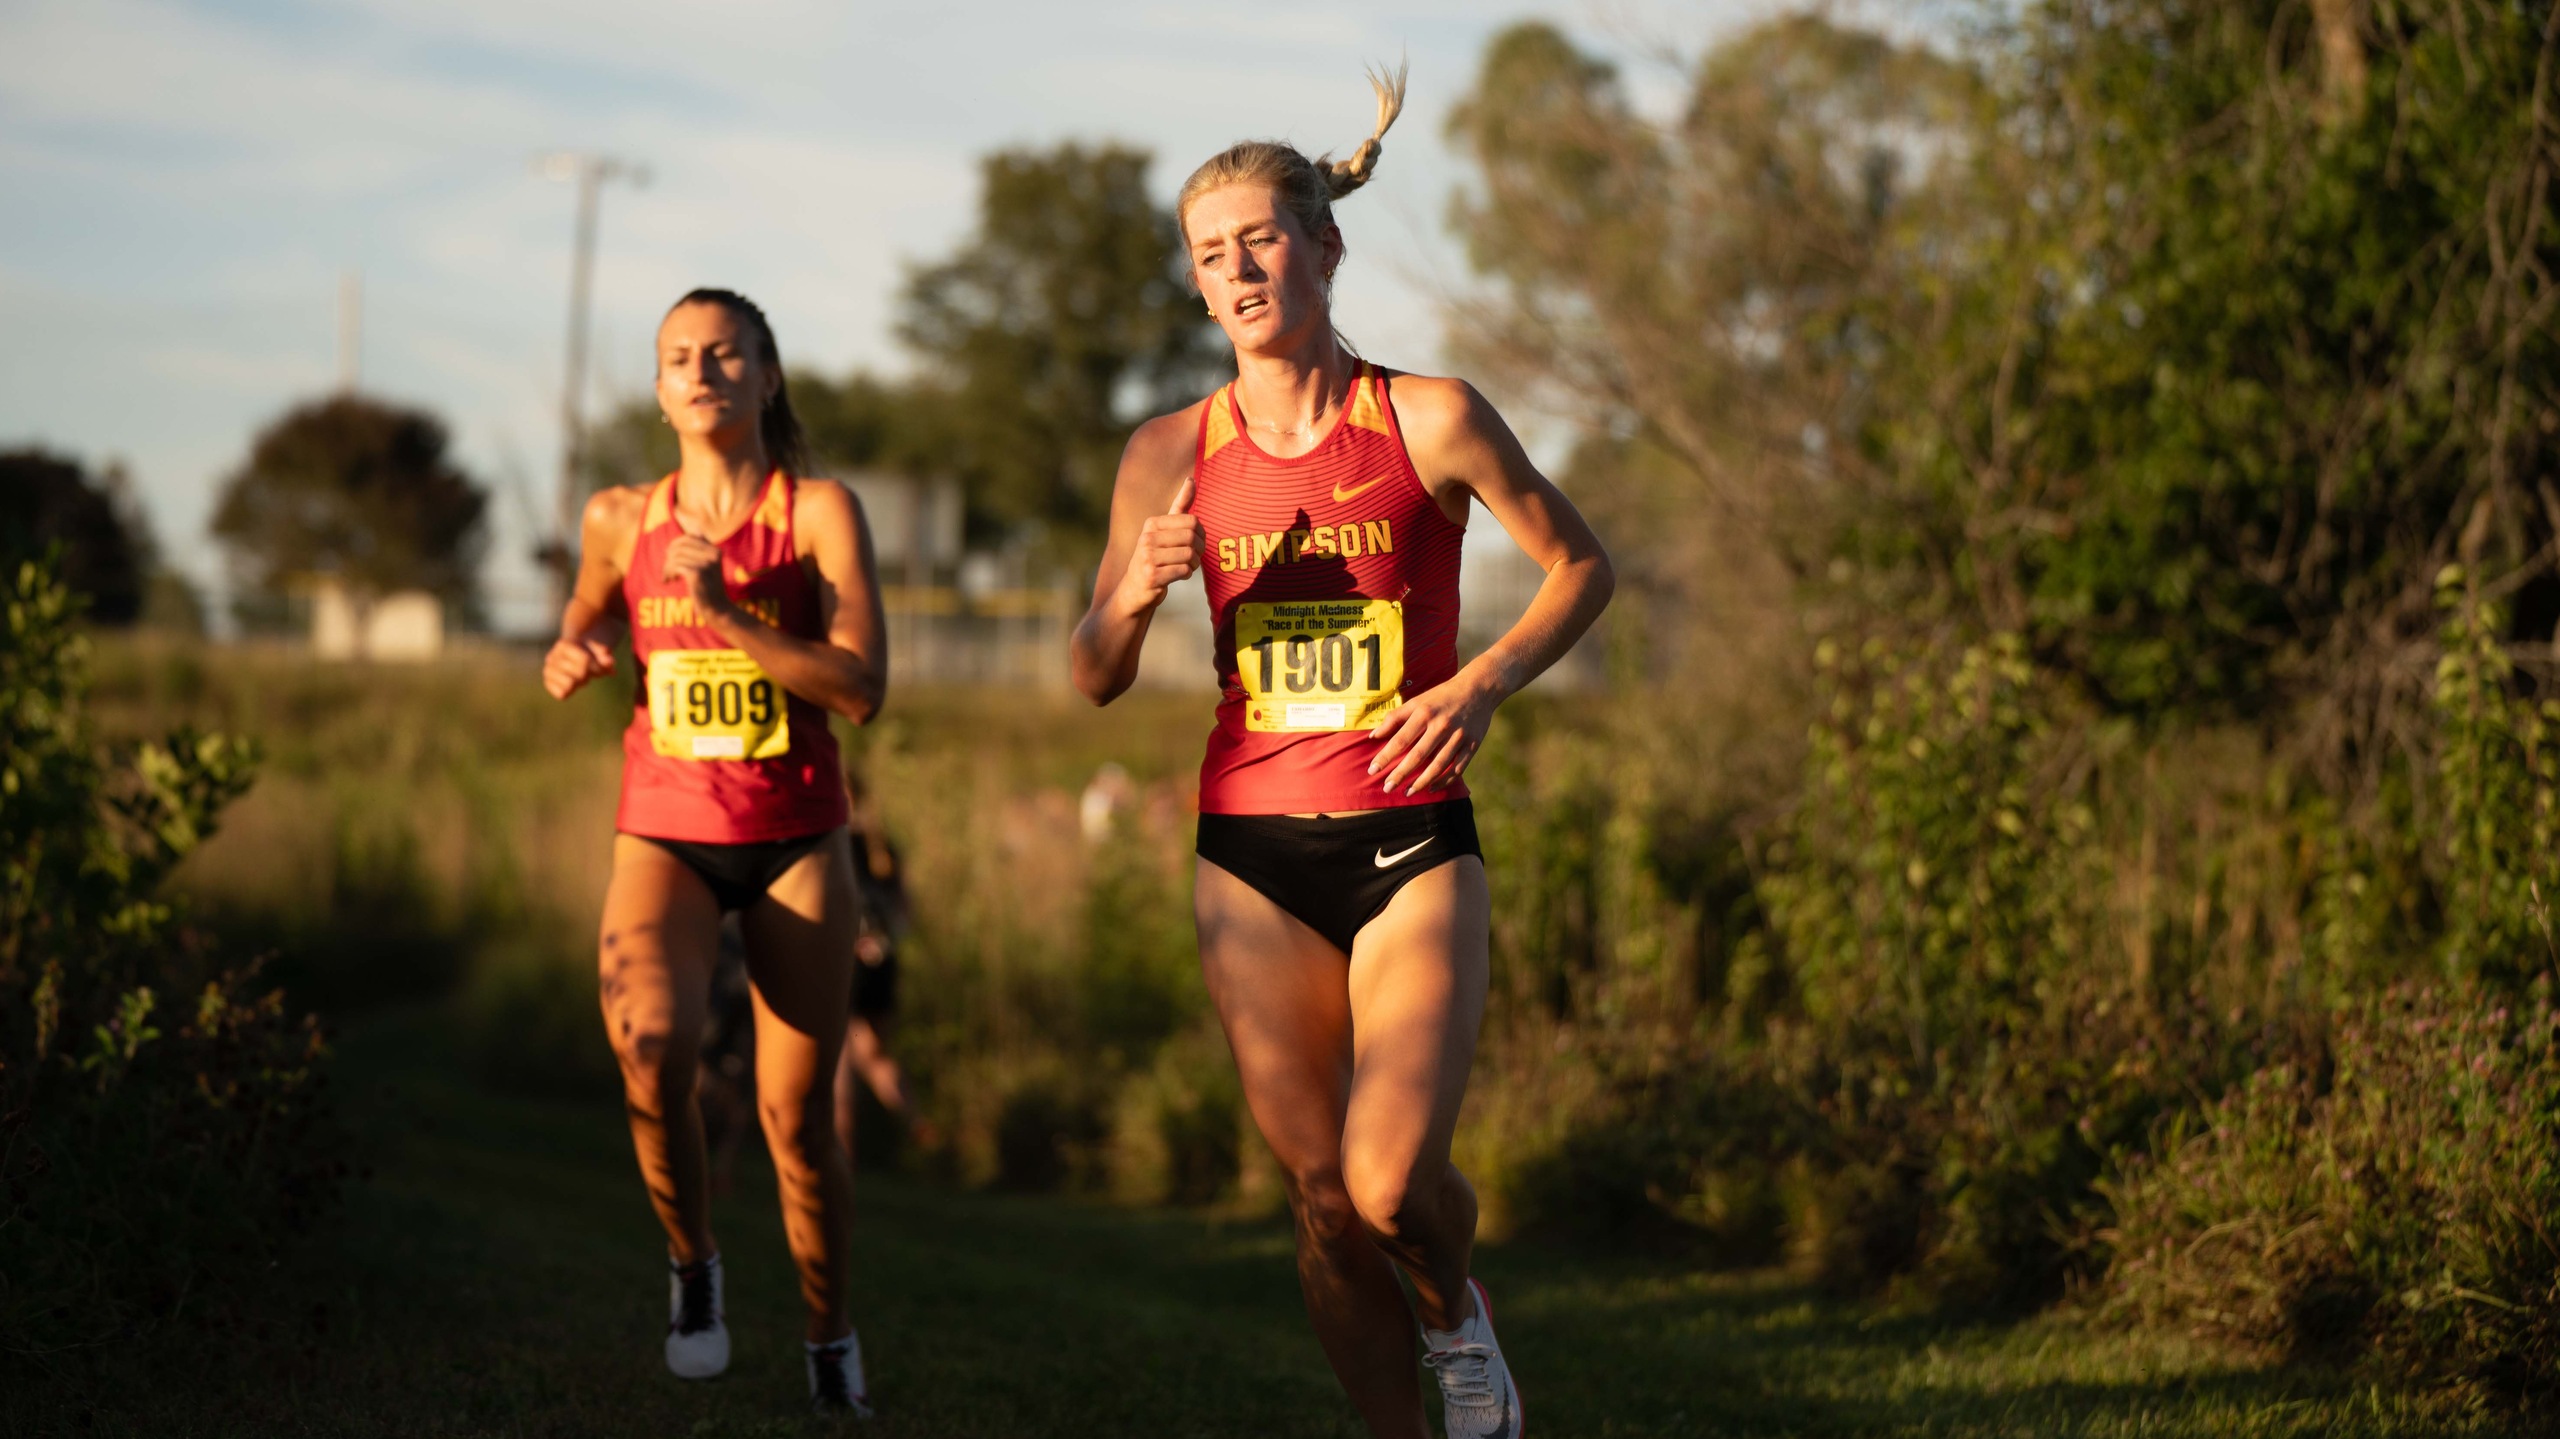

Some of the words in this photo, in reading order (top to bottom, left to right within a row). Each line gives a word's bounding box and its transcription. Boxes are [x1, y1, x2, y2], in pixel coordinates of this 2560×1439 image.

[1218, 519, 1394, 573] SIMPSON
[638, 597, 780, 628] SIMN
[1262, 618, 1292, 630] "Race
[1295, 618, 1305, 629] of
[1308, 618, 1324, 629] the
[1328, 617, 1376, 629] Summer"
[1273, 605, 1315, 618] Midnight
[1318, 604, 1364, 616] Madness
[1251, 633, 1381, 693] 1901
[664, 679, 773, 726] 1909
